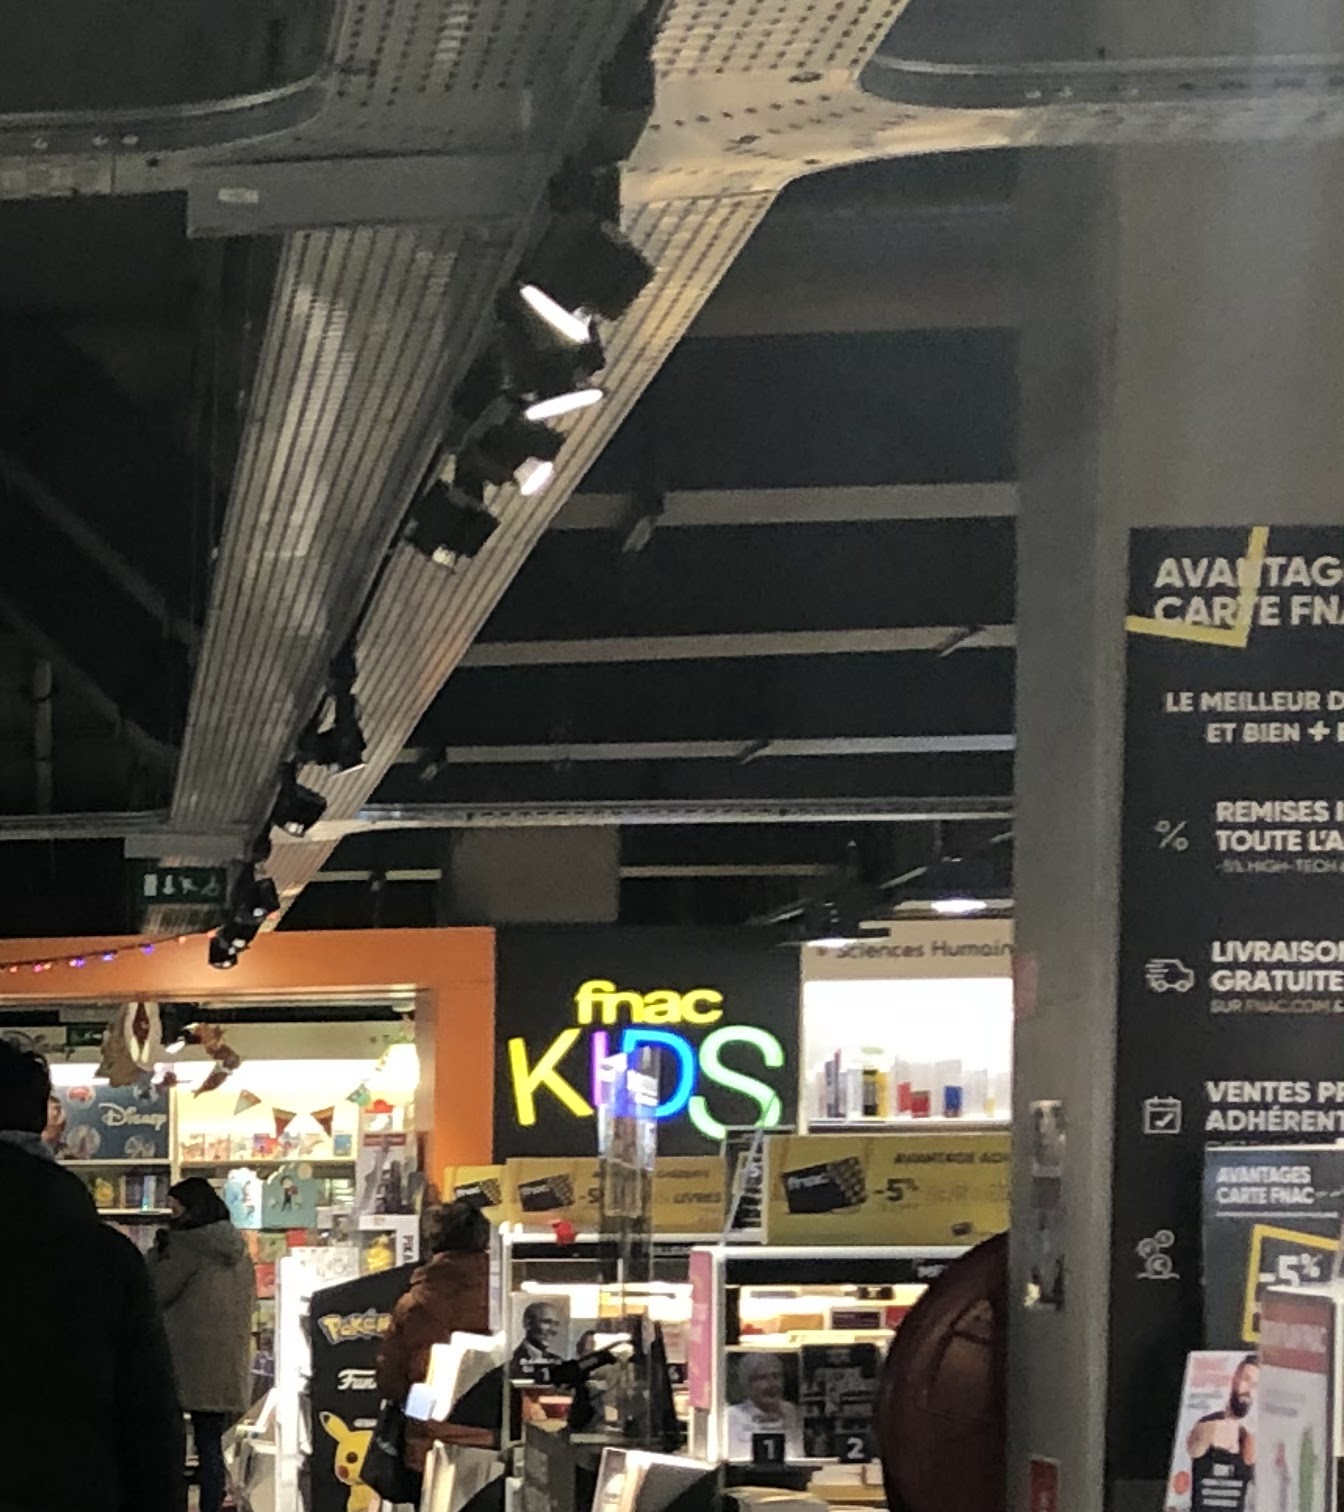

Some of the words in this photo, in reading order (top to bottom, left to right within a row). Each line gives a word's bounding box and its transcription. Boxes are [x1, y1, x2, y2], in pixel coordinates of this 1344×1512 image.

[1166, 692, 1193, 712] LE
[1200, 691, 1321, 712] MEILLEUR
[1207, 722, 1235, 743] ET
[1243, 722, 1300, 743] BIEN
[1216, 801, 1329, 822] REMISES
[1216, 830, 1302, 851] TOUTE
[1210, 969, 1343, 992] GRATUITE
[576, 980, 724, 1025] fnac
[507, 1025, 785, 1140] KIDS
[1205, 1081, 1312, 1103] VENTES
[98, 1103, 167, 1131] Disney
[1216, 1166, 1311, 1185] AVANTAGES
[1216, 1187, 1270, 1204] CARTE
[1273, 1187, 1314, 1204] FNAC
[762, 1438, 776, 1460] 1
[846, 1436, 864, 1459] 2
